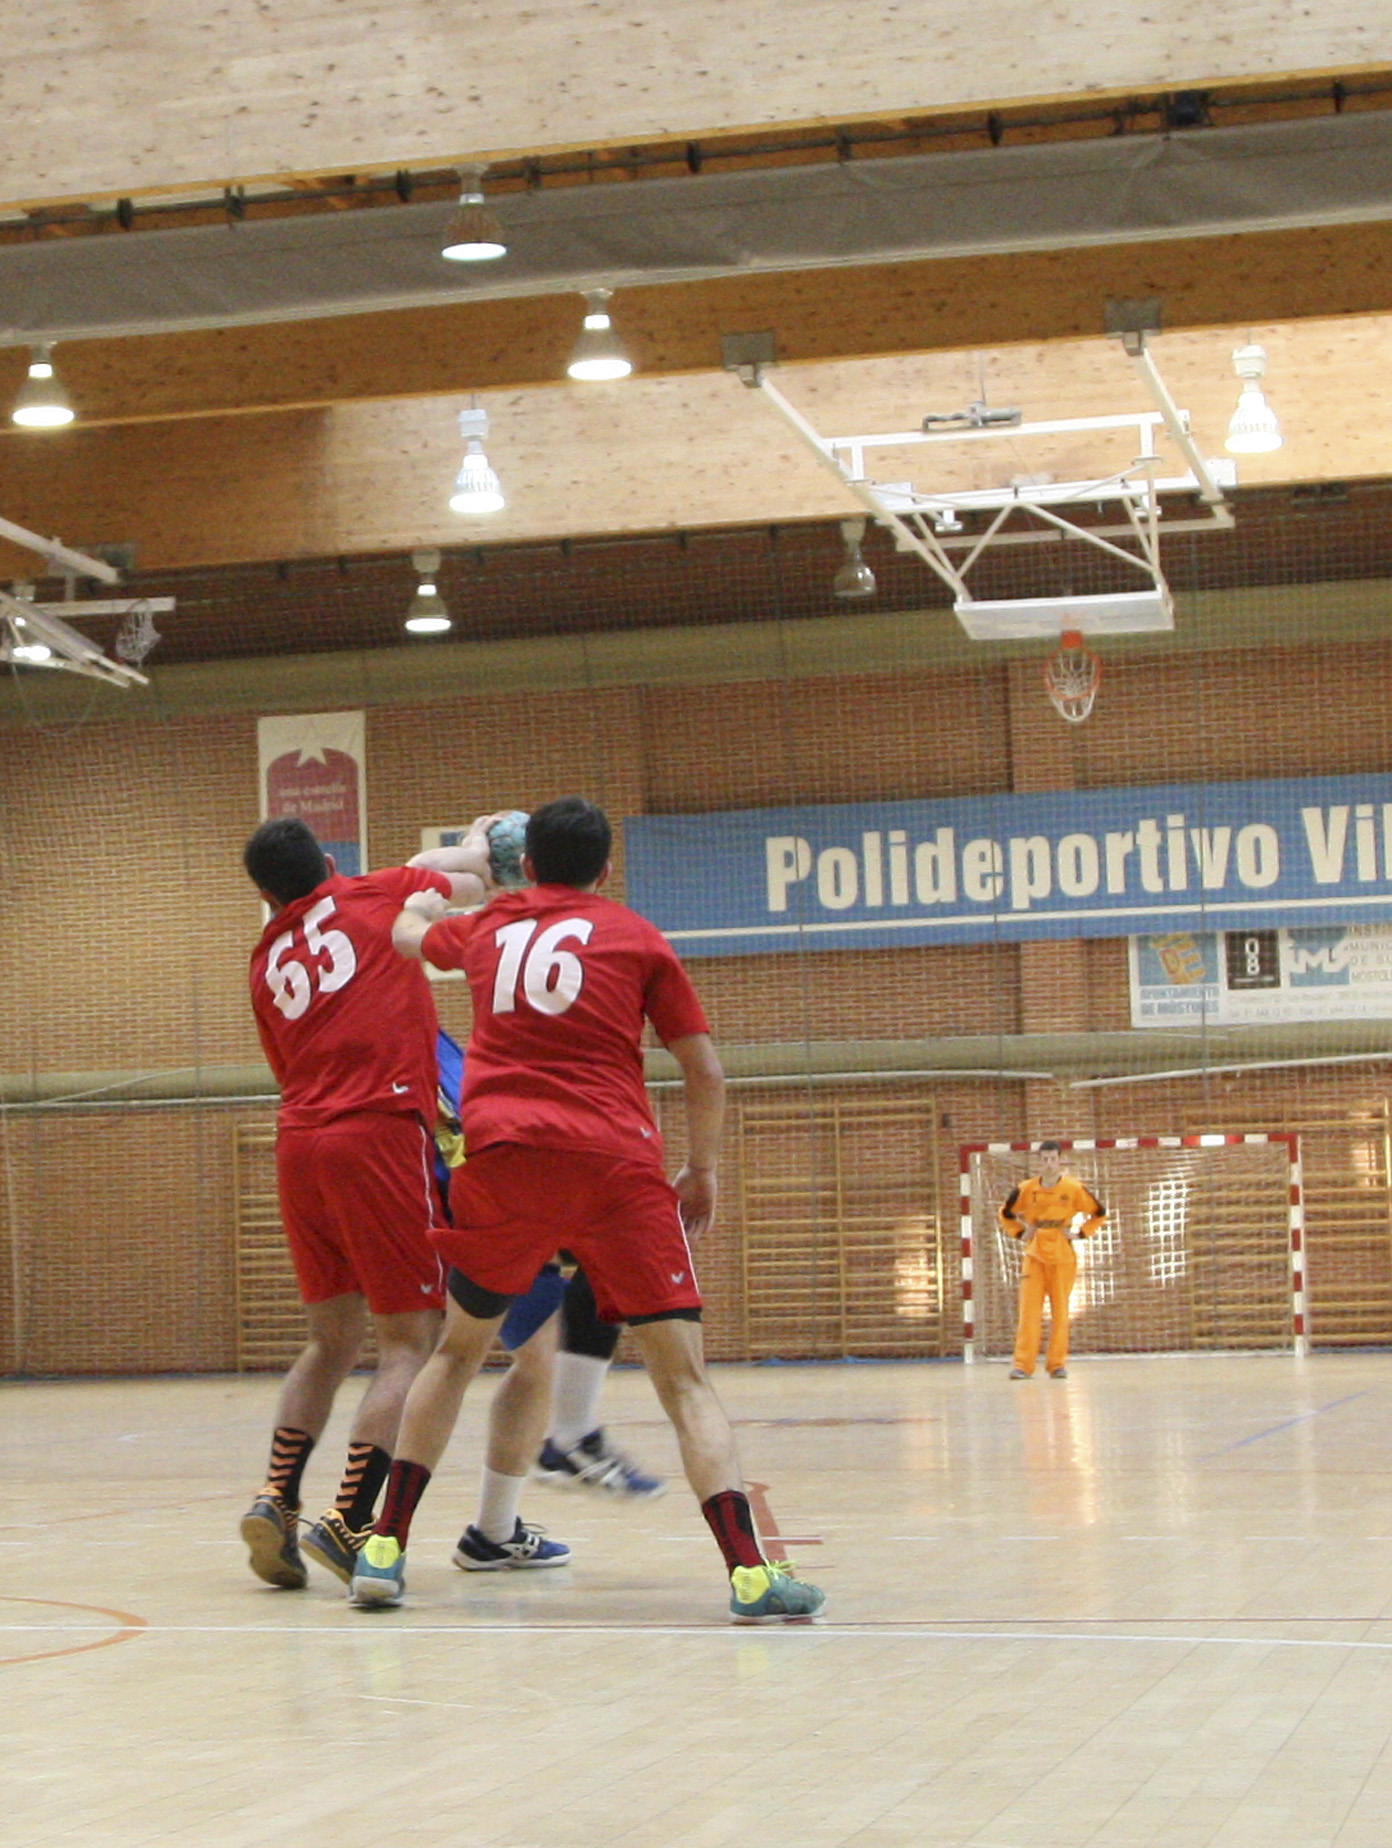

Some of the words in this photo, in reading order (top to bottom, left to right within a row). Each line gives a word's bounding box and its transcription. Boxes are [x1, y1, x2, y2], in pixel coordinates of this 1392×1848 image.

[766, 812, 1280, 912] Polideportivo
[265, 896, 356, 1020] 65
[493, 918, 594, 1016] 16
